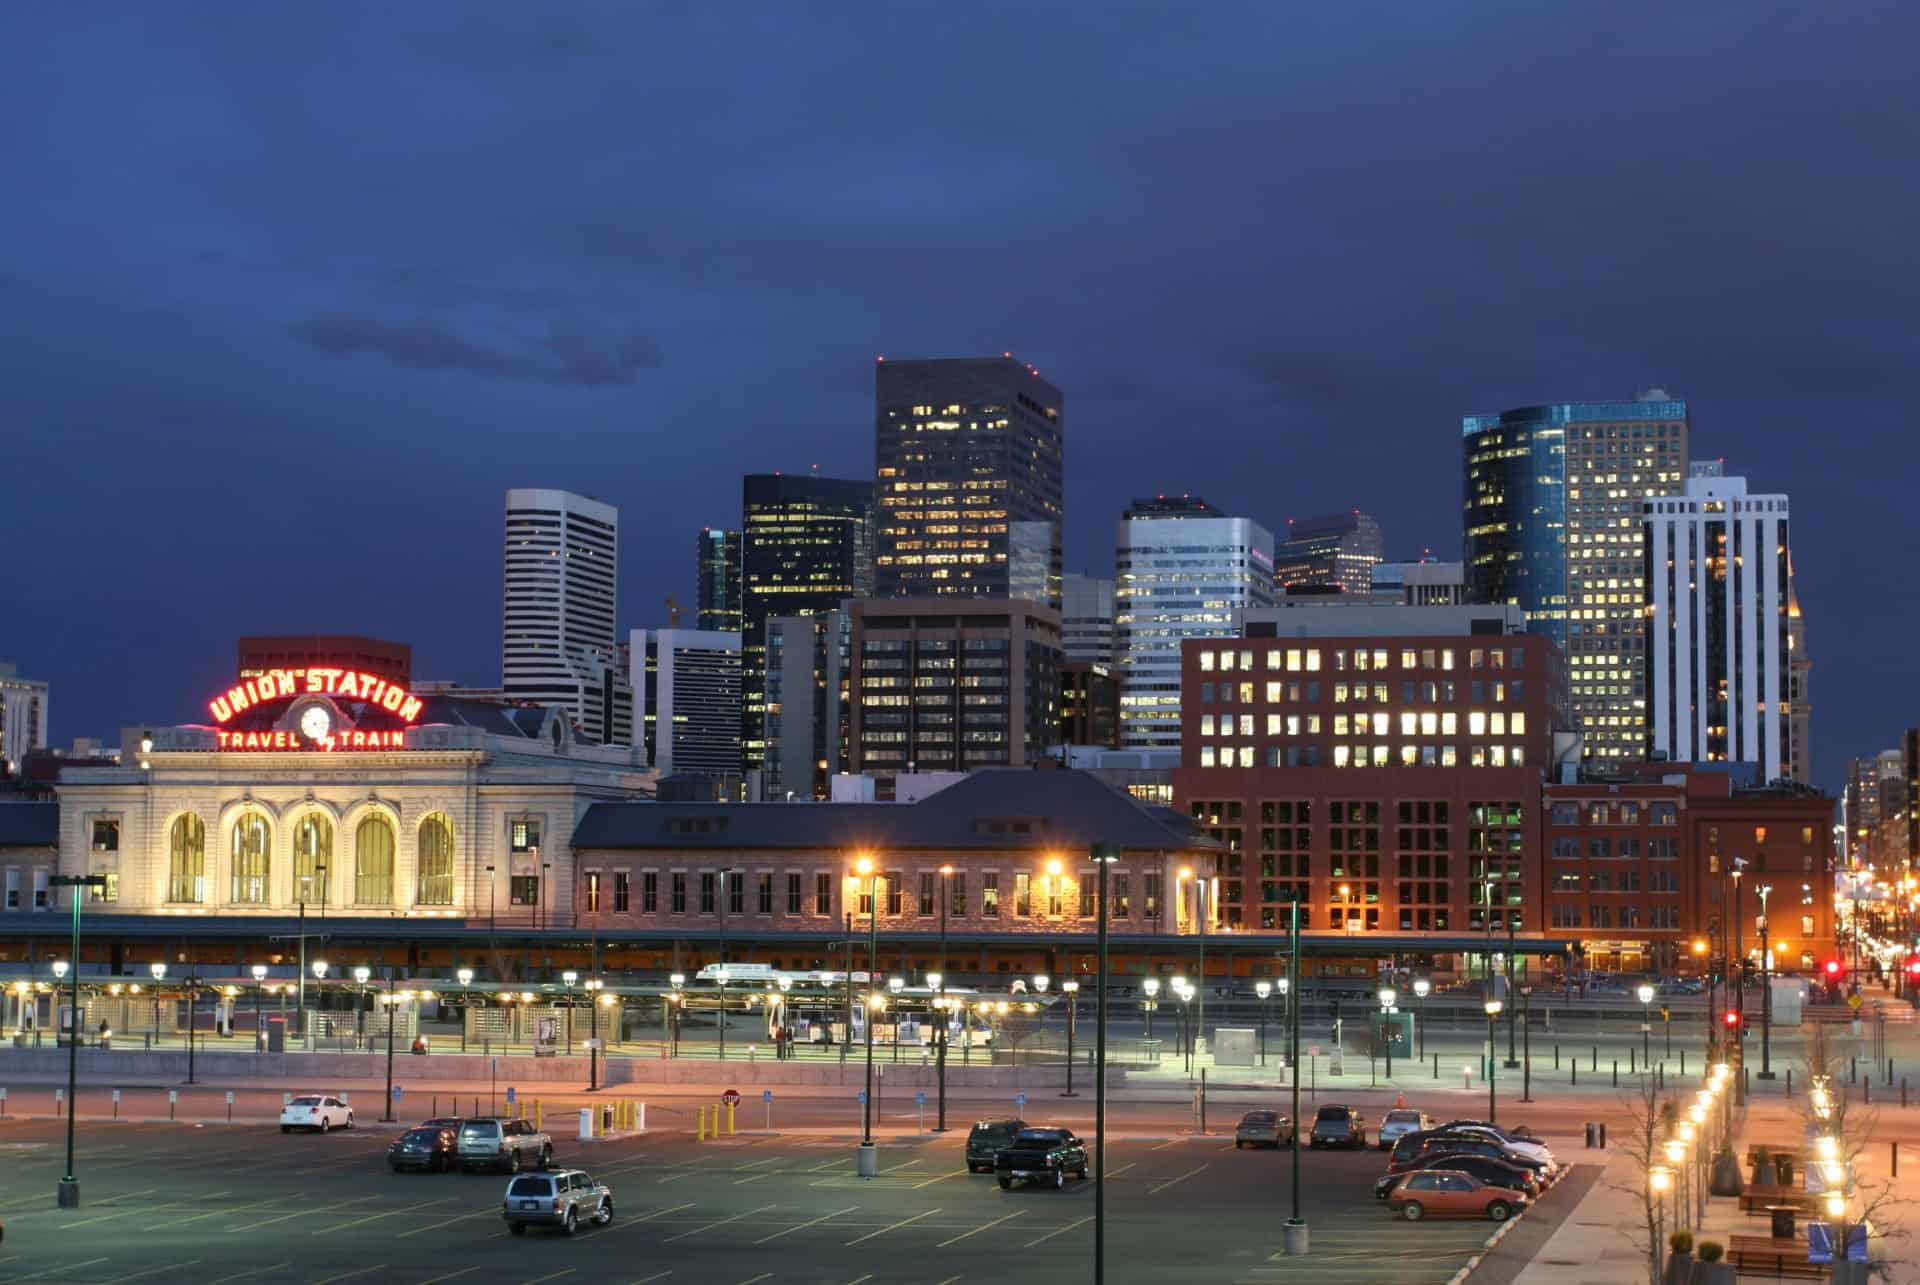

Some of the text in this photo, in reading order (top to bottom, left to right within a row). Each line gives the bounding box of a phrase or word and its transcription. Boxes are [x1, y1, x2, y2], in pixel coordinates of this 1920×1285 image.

[209, 667, 423, 723] UNION STATION
[218, 731, 301, 748] TRAVEL
[341, 730, 404, 747] TRAIN
